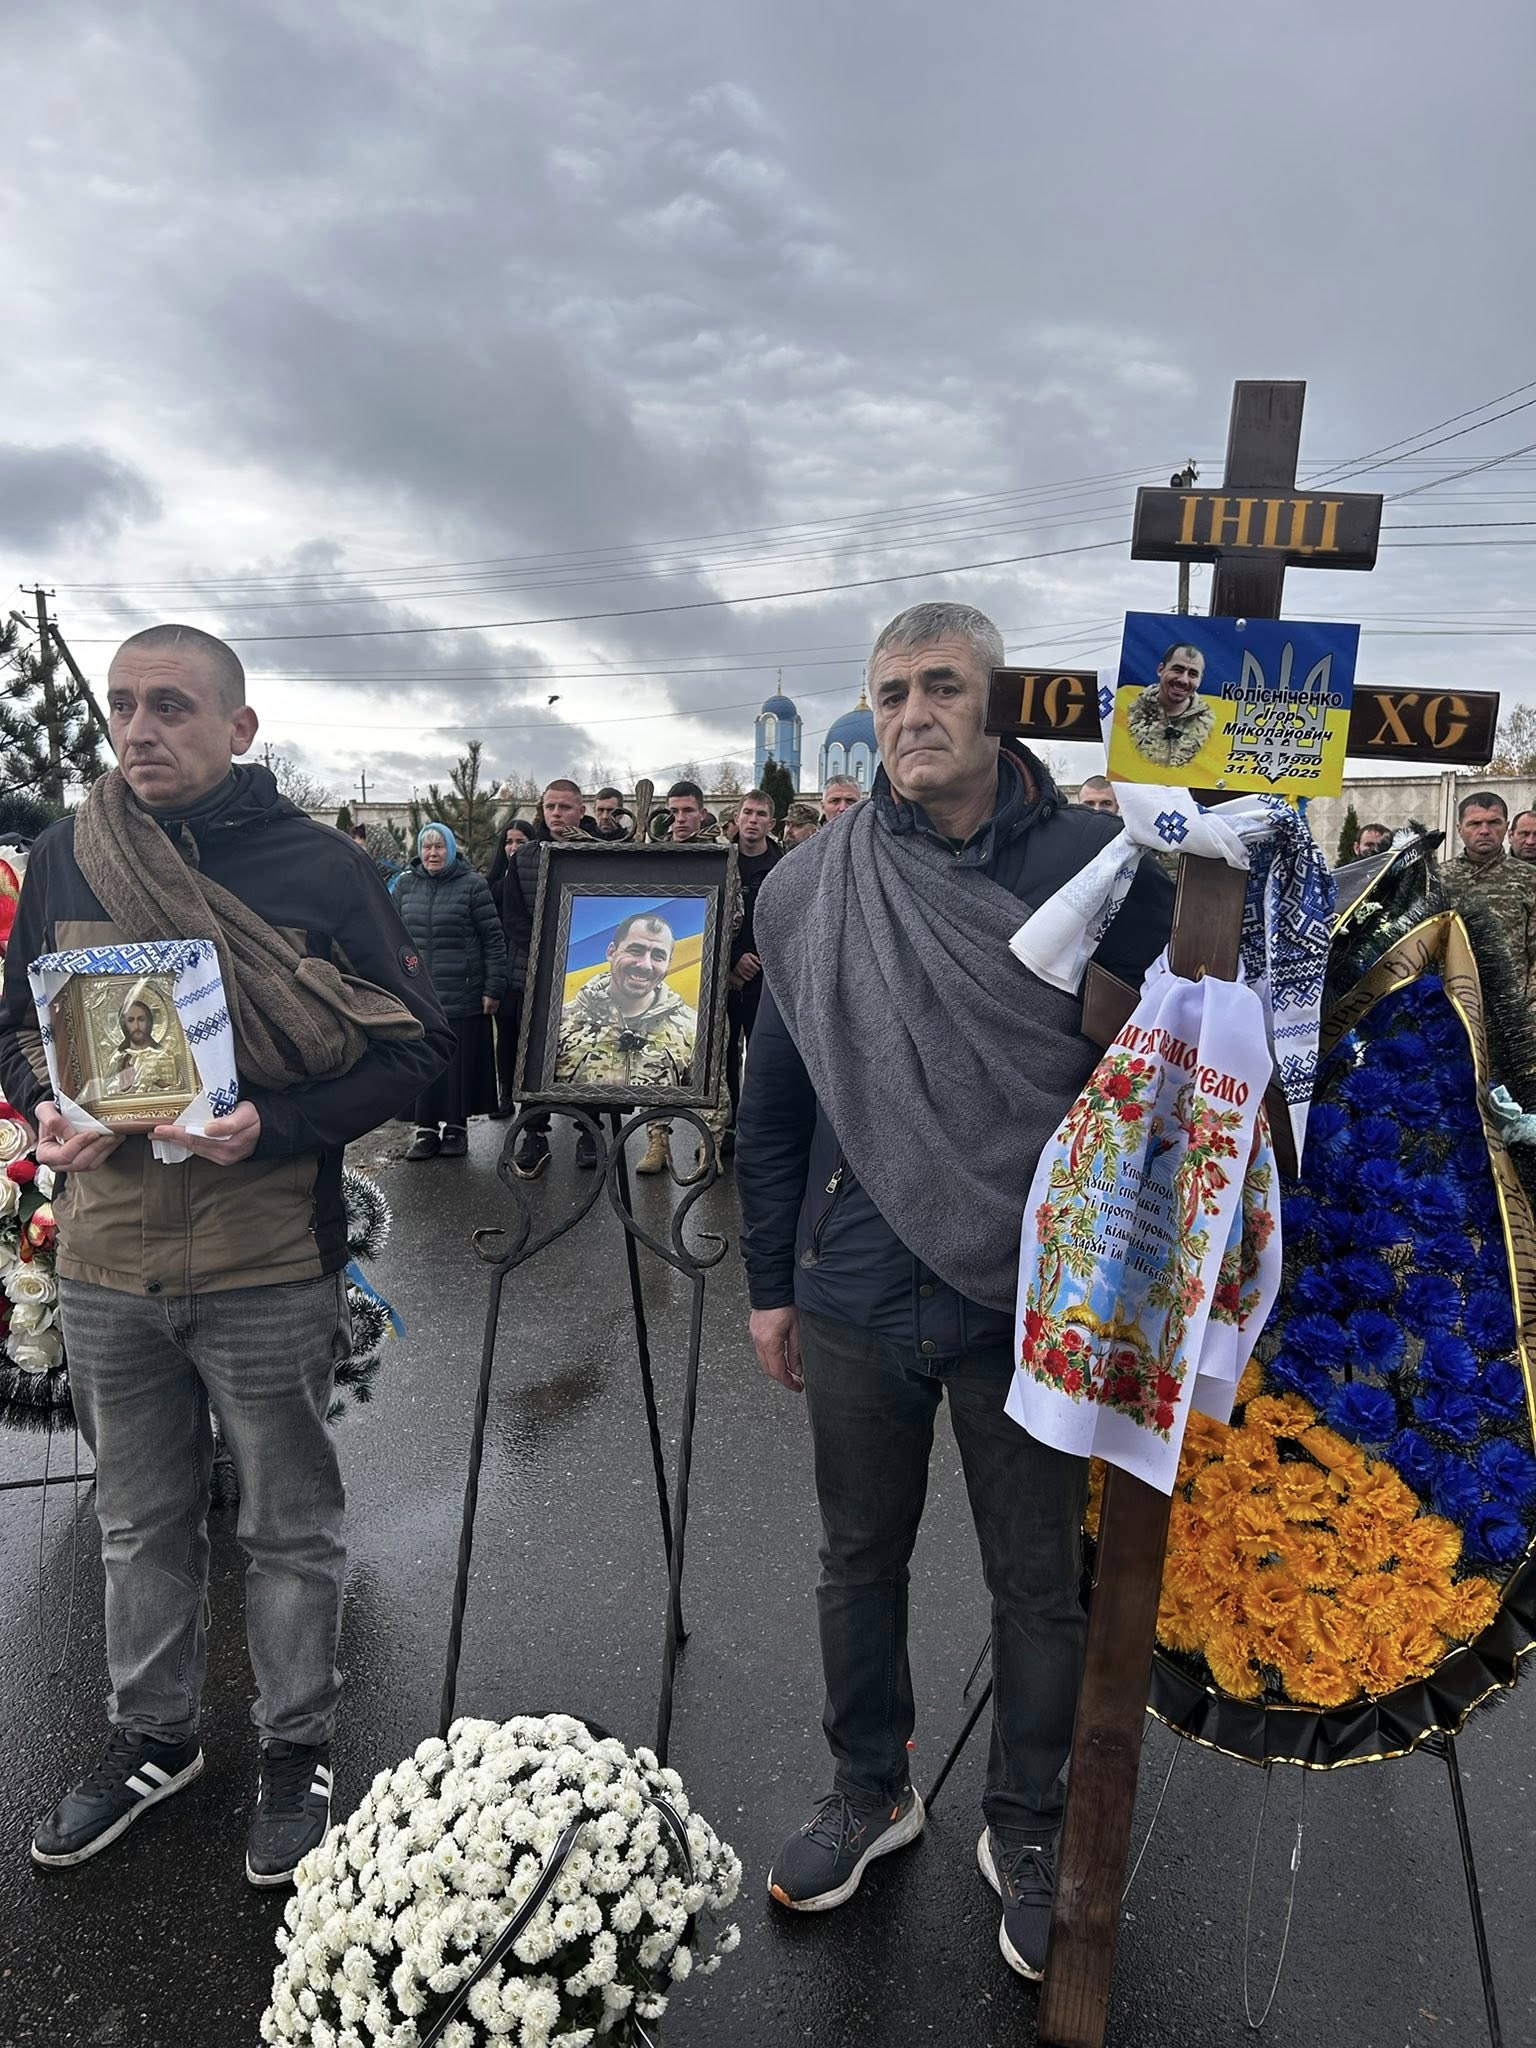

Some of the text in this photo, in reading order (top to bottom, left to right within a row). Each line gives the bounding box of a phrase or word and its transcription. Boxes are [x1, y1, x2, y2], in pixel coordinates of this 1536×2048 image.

[1221, 682, 1342, 707] Колісніченко
[1263, 707, 1296, 723] Ігор
[1222, 722, 1333, 741] Миколайович
[1283, 755, 1323, 766] 1990
[1279, 767, 1322, 779] 2025
